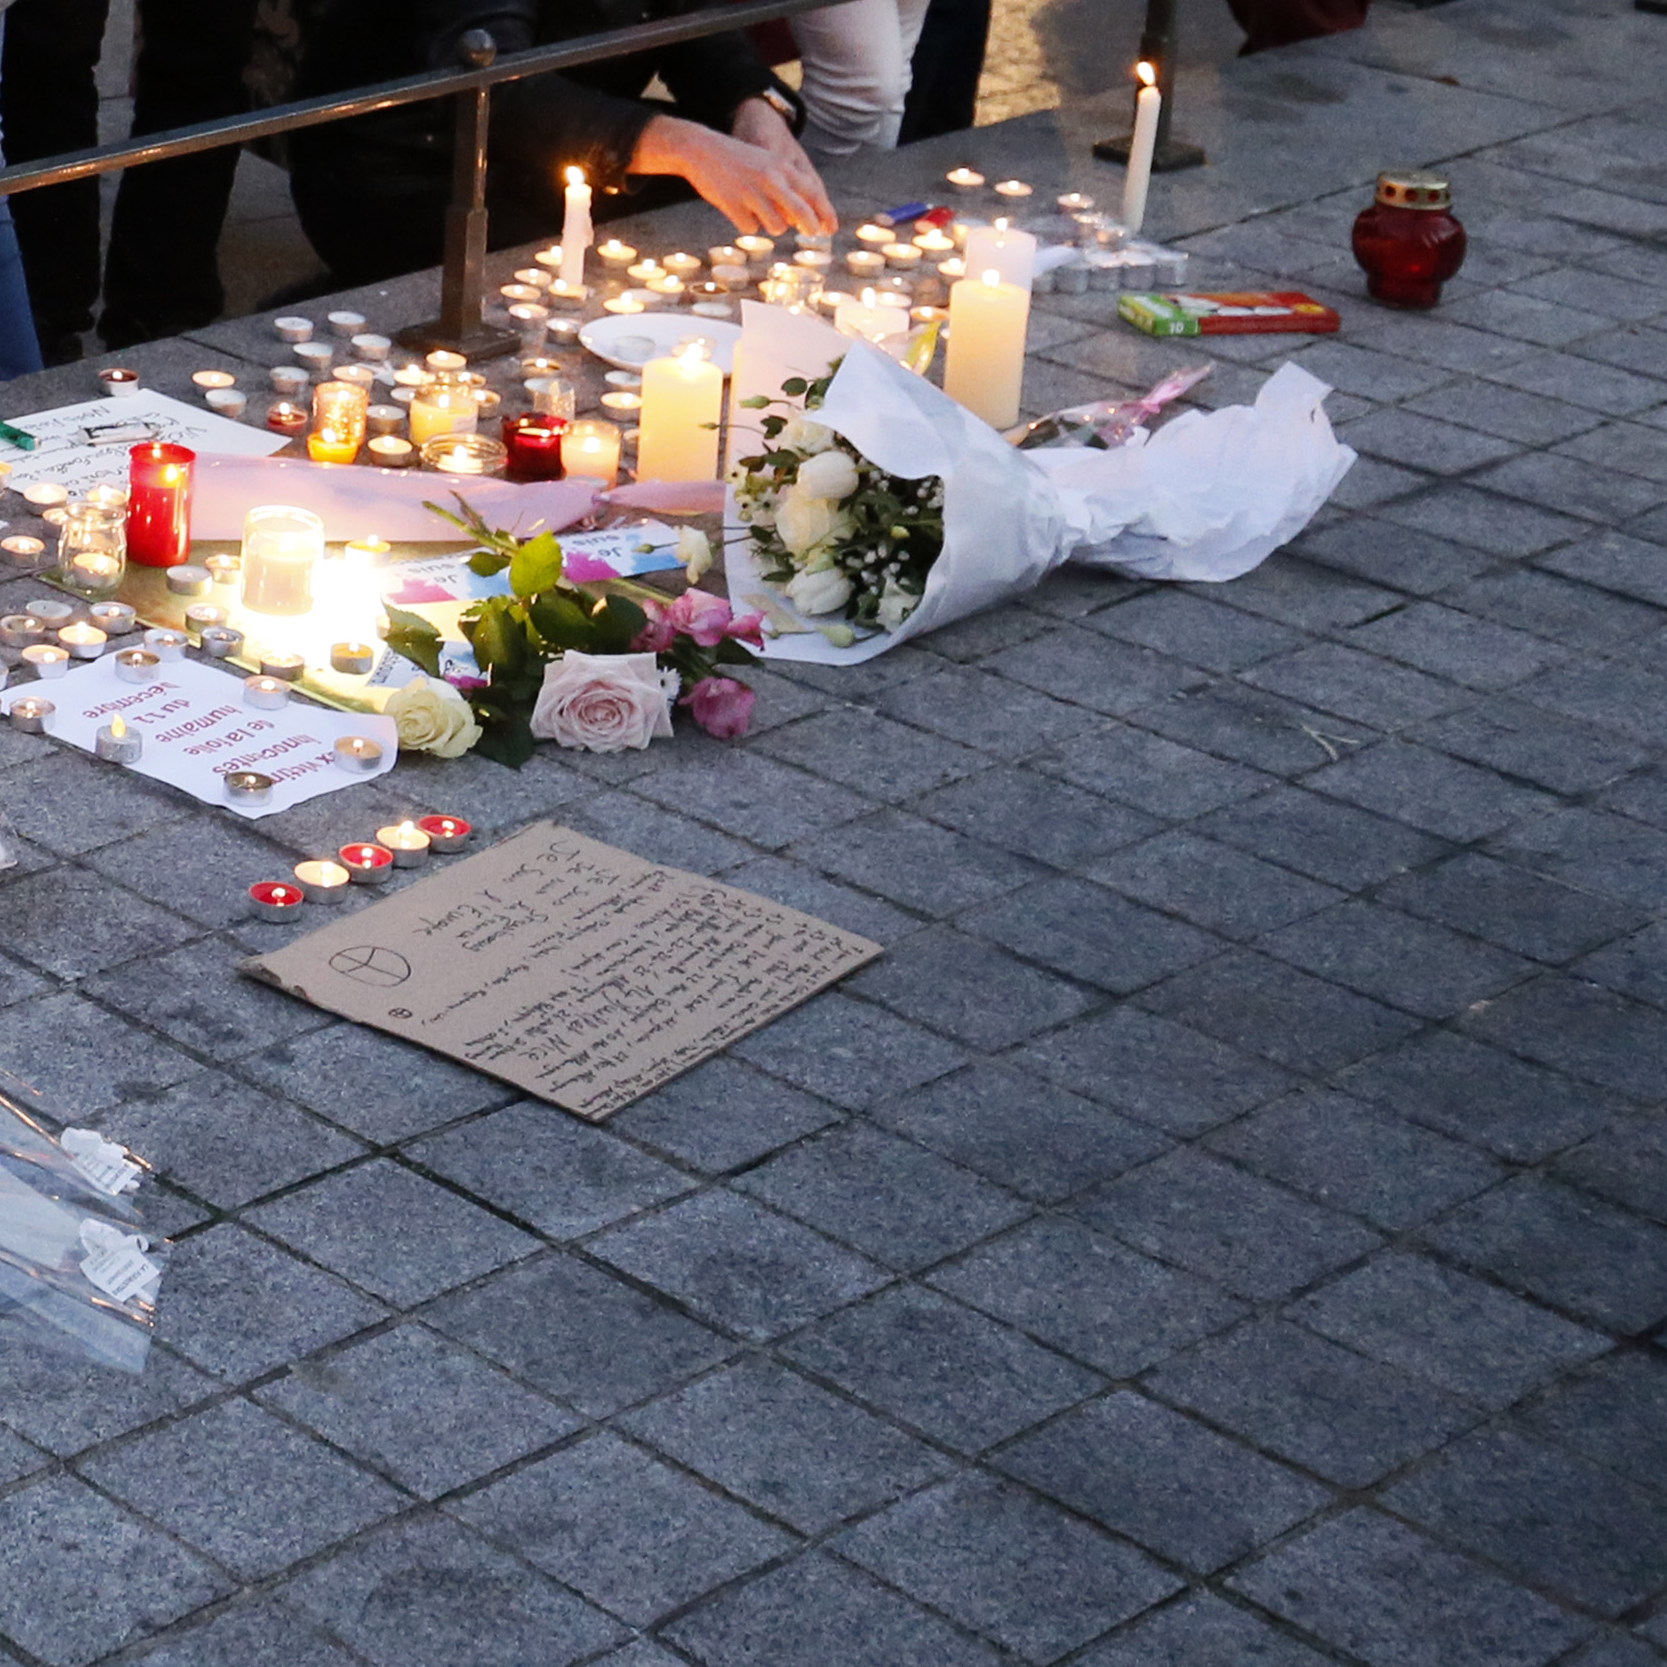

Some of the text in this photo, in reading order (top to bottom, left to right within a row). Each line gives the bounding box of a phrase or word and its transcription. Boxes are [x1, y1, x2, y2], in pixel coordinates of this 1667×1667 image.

[132, 699, 190, 725] du 11
[154, 704, 243, 745] humaine
[182, 719, 275, 758] de la folie
[212, 734, 321, 776] innocentes
